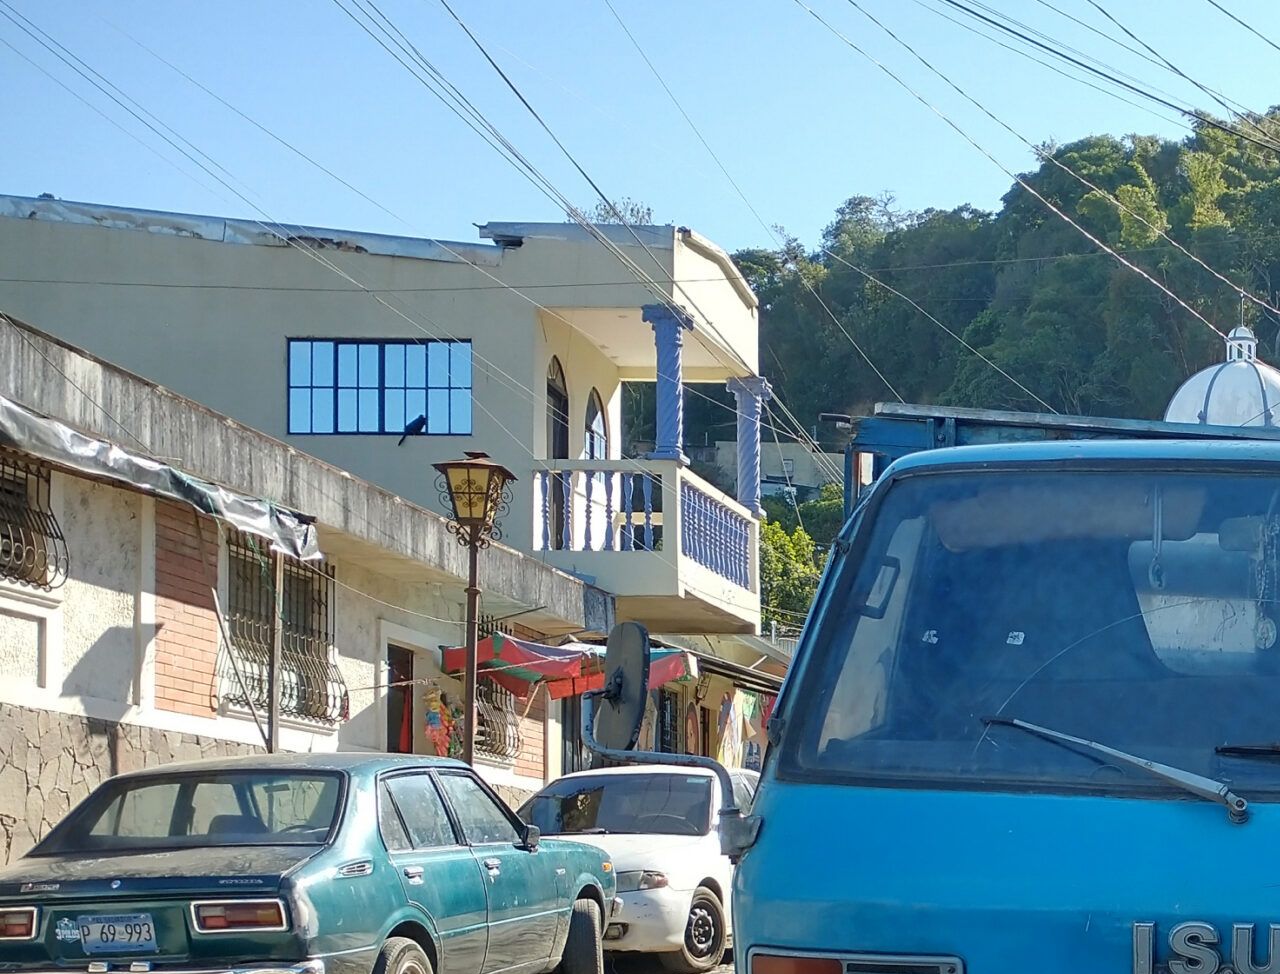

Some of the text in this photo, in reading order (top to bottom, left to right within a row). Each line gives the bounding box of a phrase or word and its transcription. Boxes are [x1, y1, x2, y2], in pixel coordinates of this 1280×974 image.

[81, 923, 153, 944] P 69 993
